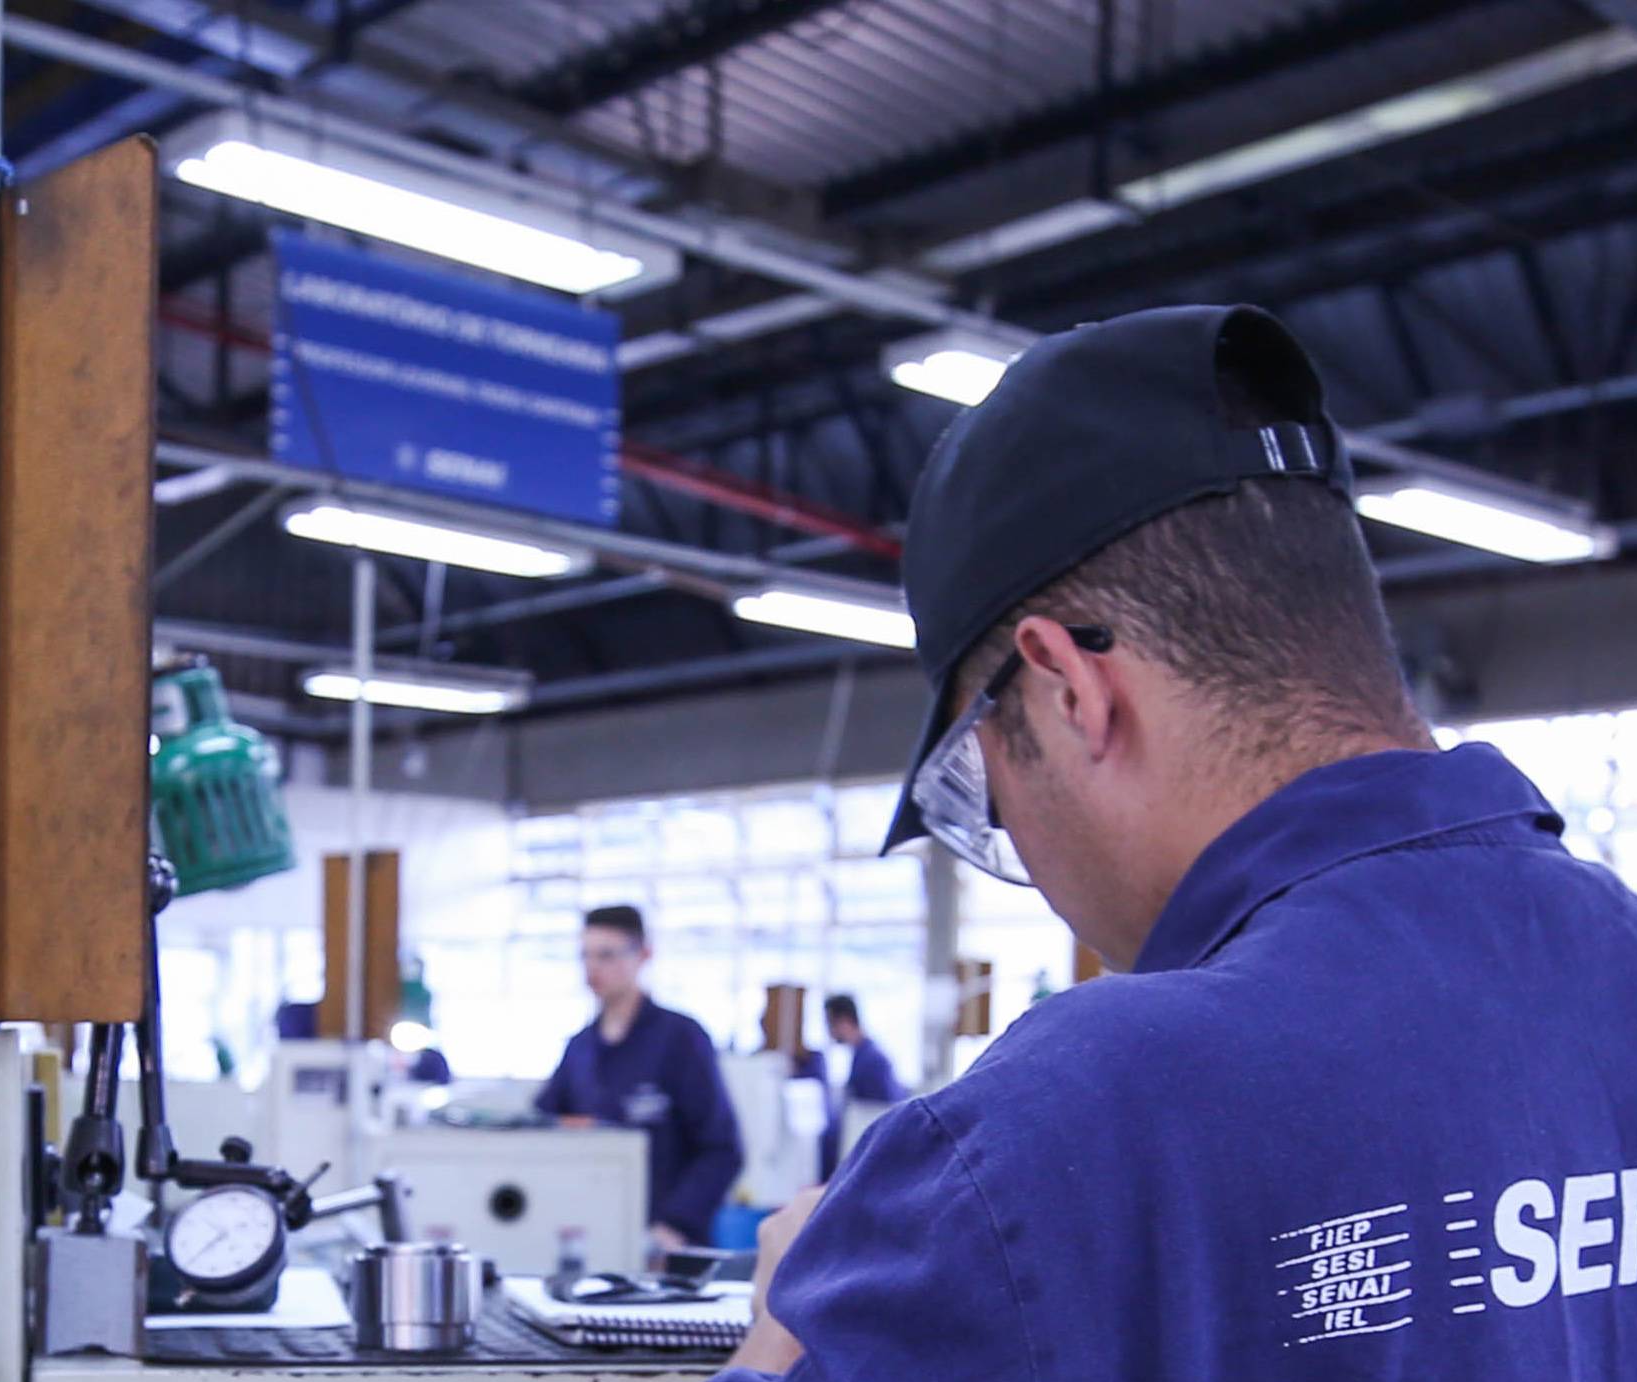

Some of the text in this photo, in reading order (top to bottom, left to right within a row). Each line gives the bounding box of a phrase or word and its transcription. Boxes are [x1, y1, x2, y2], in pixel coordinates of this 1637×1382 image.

[1310, 1219, 1372, 1251] FIEP
[1311, 1248, 1375, 1279] SESI
[1301, 1274, 1391, 1309] SENAI
[1324, 1308, 1369, 1331] IEL
